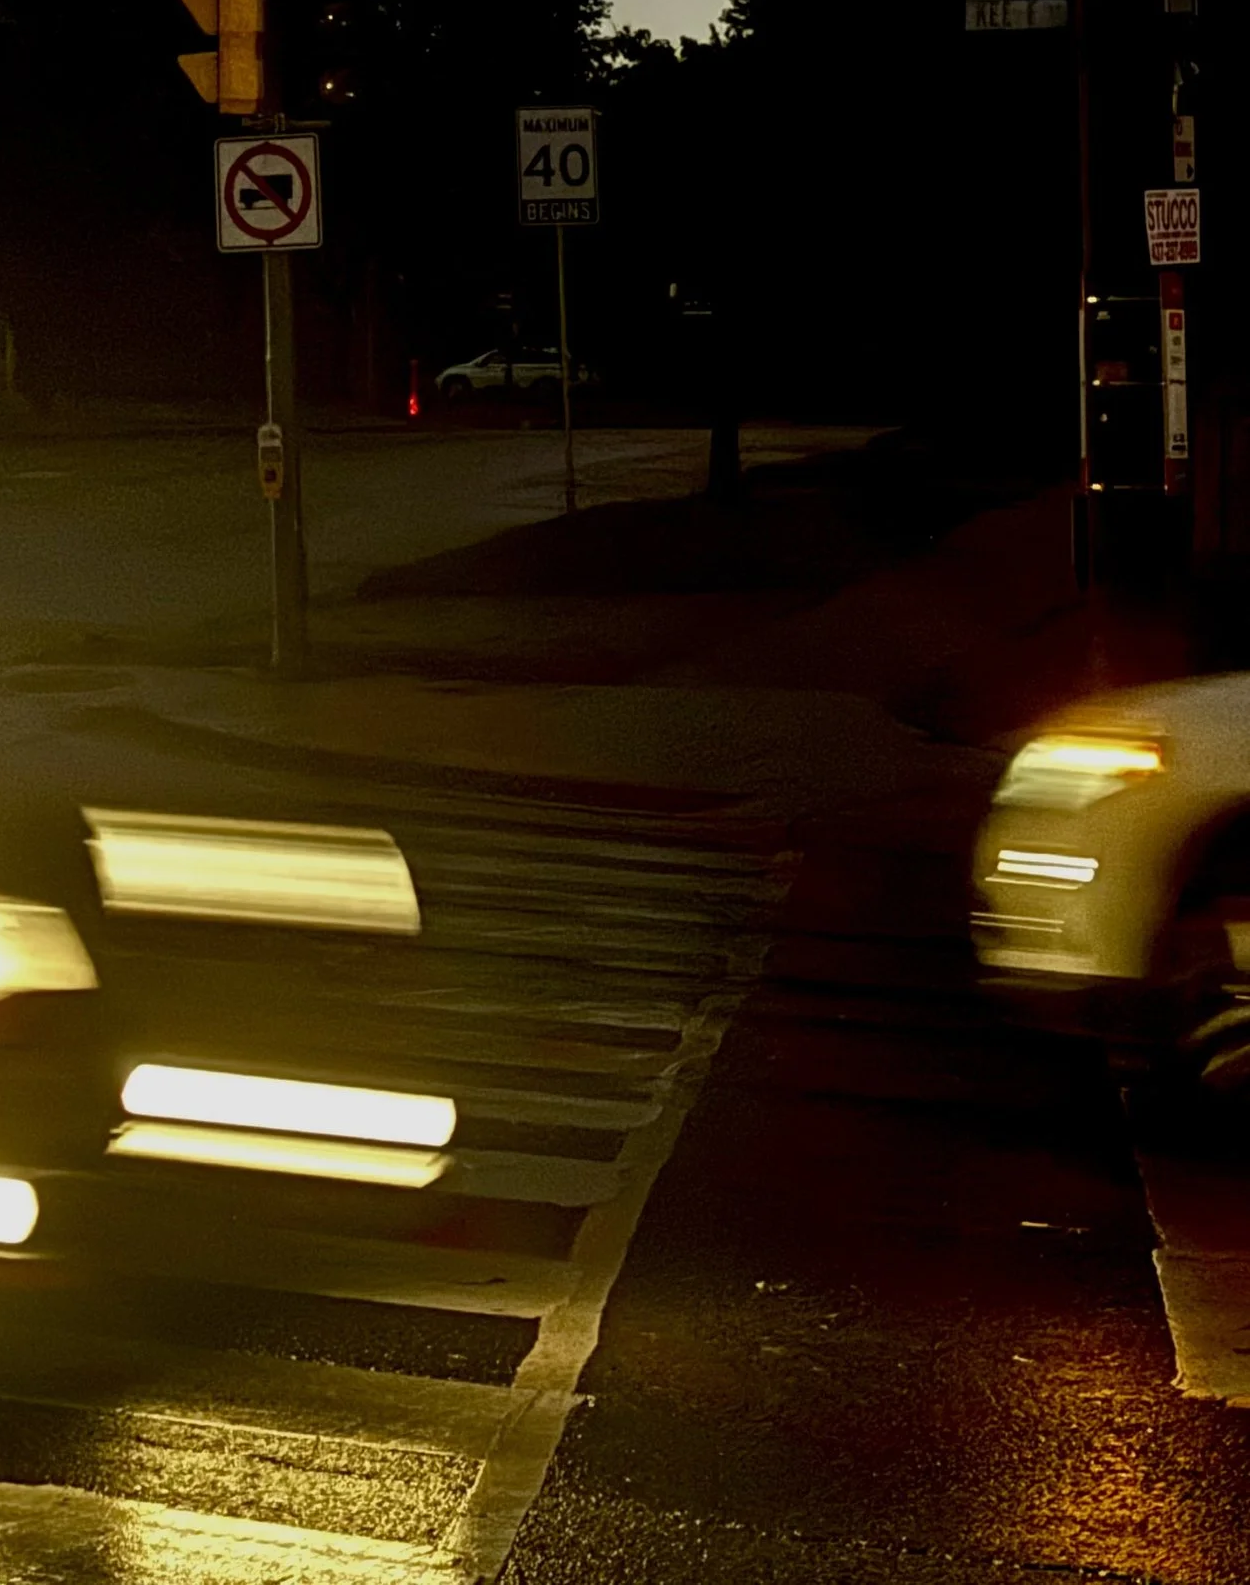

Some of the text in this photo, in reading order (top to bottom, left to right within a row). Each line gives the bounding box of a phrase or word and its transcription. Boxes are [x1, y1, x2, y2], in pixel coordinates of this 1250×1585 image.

[523, 118, 589, 132] MAXIMUM
[523, 144, 590, 186] 40
[526, 201, 591, 221] BEGINS
[1147, 198, 1197, 231] STUCCO
